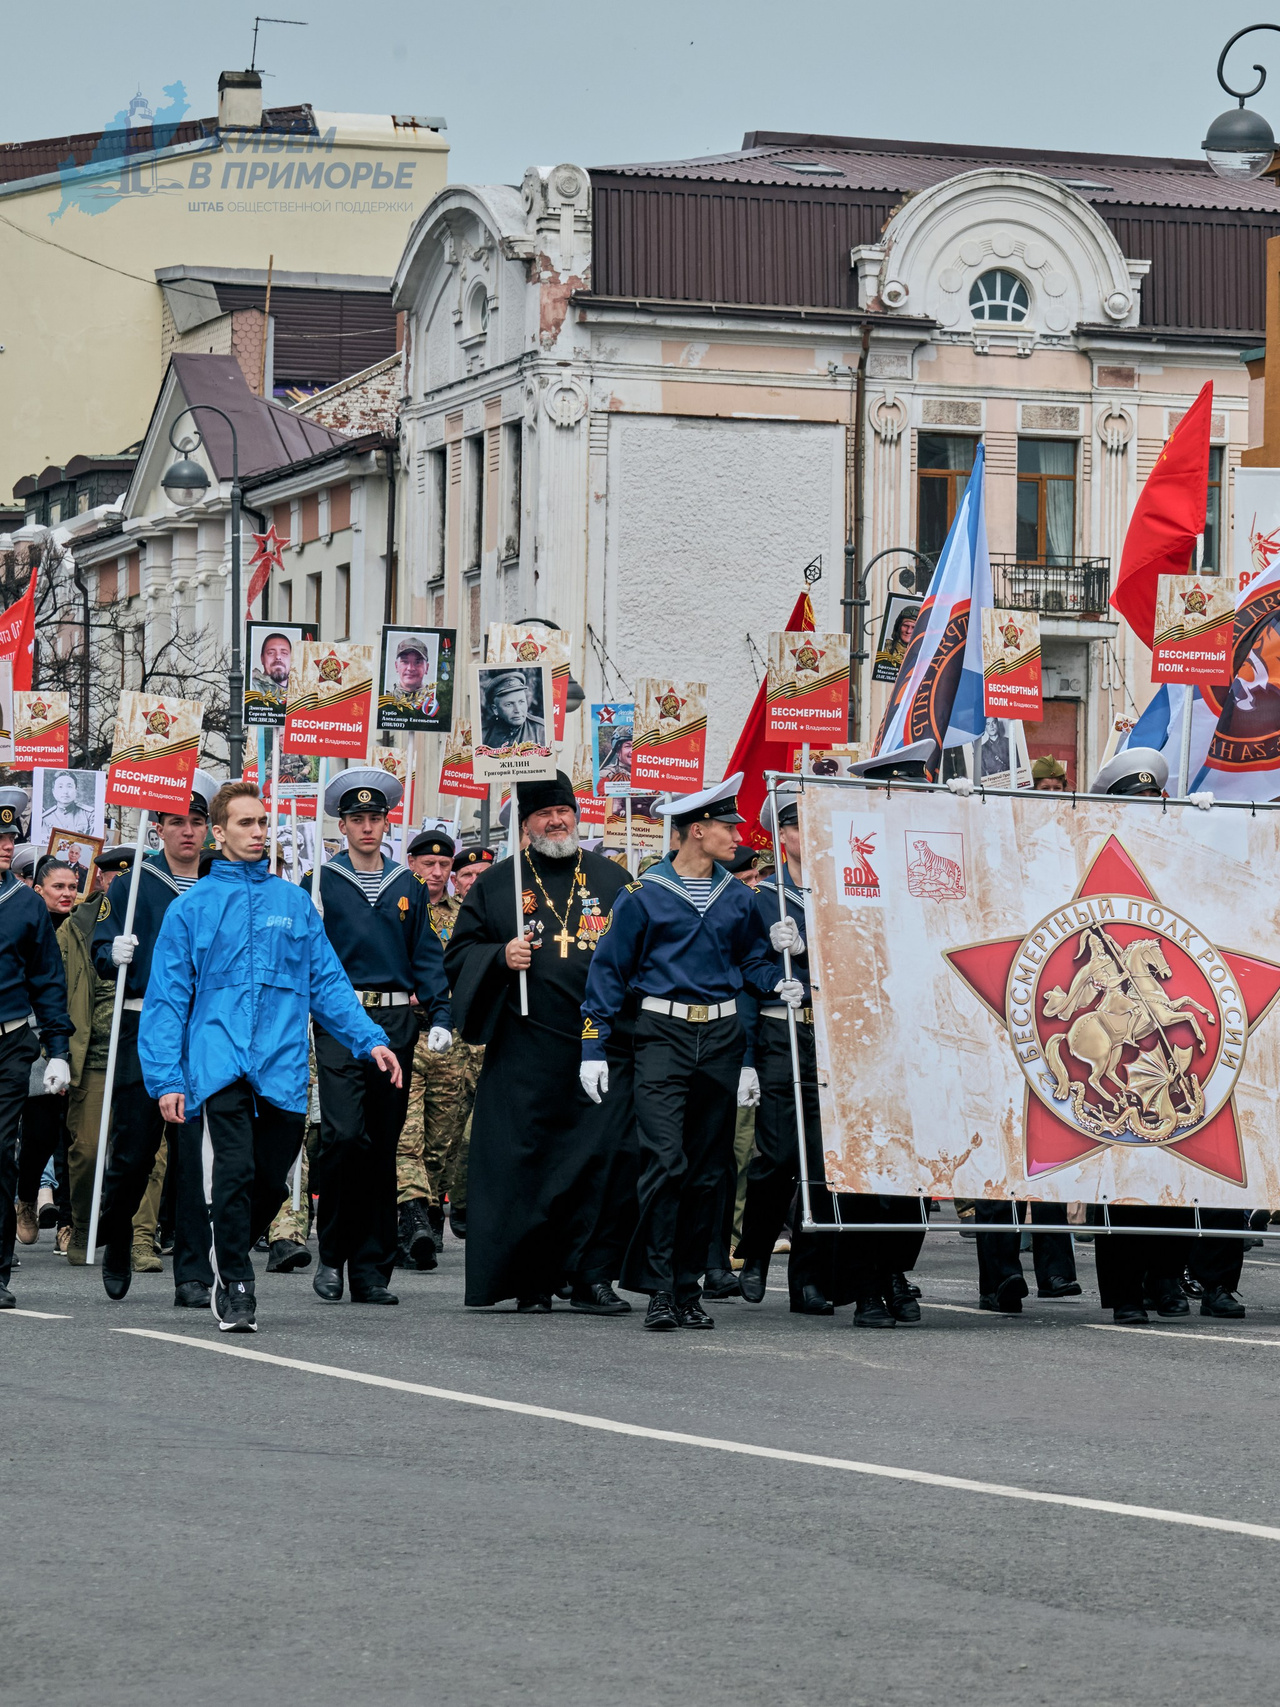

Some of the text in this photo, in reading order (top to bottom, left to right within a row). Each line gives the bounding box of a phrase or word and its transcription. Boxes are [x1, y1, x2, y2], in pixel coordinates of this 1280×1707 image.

[1238, 571, 1261, 592] 8
[1159, 649, 1226, 661] БЕССМЕРТНЫЙ
[1158, 662, 1225, 674] ПОЛК Владивосток
[988, 683, 1039, 697] БЕССМЕРТНЫЙ
[988, 697, 1039, 709] ПОЛК Владивосток
[771, 707, 842, 719] БЕССМЕРТНЫЙ
[291, 718, 363, 733] БЕССМЕРТНЫЙ
[770, 721, 841, 732] ПОЛК Владивосток
[290, 732, 361, 747] ПОЛК Владивосток
[499, 760, 530, 768] ЖИЛИН
[636, 754, 699, 769] БЕССМЕРТНЫЙ
[114, 768, 187, 789] БЕССМЕРТНЫЙ
[444, 769, 474, 780] БЕССМЕРТ
[636, 768, 698, 782] ПОЛК Владивосток
[442, 779, 459, 788] ПОЛК
[112, 783, 184, 802] ПОЛК Владивосток
[843, 867, 862, 885] 80
[844, 887, 881, 899] ПОБЕДА!
[1010, 897, 1244, 1071] БЕССМЕРТНЫЙ ПОЛК РОССИИ
